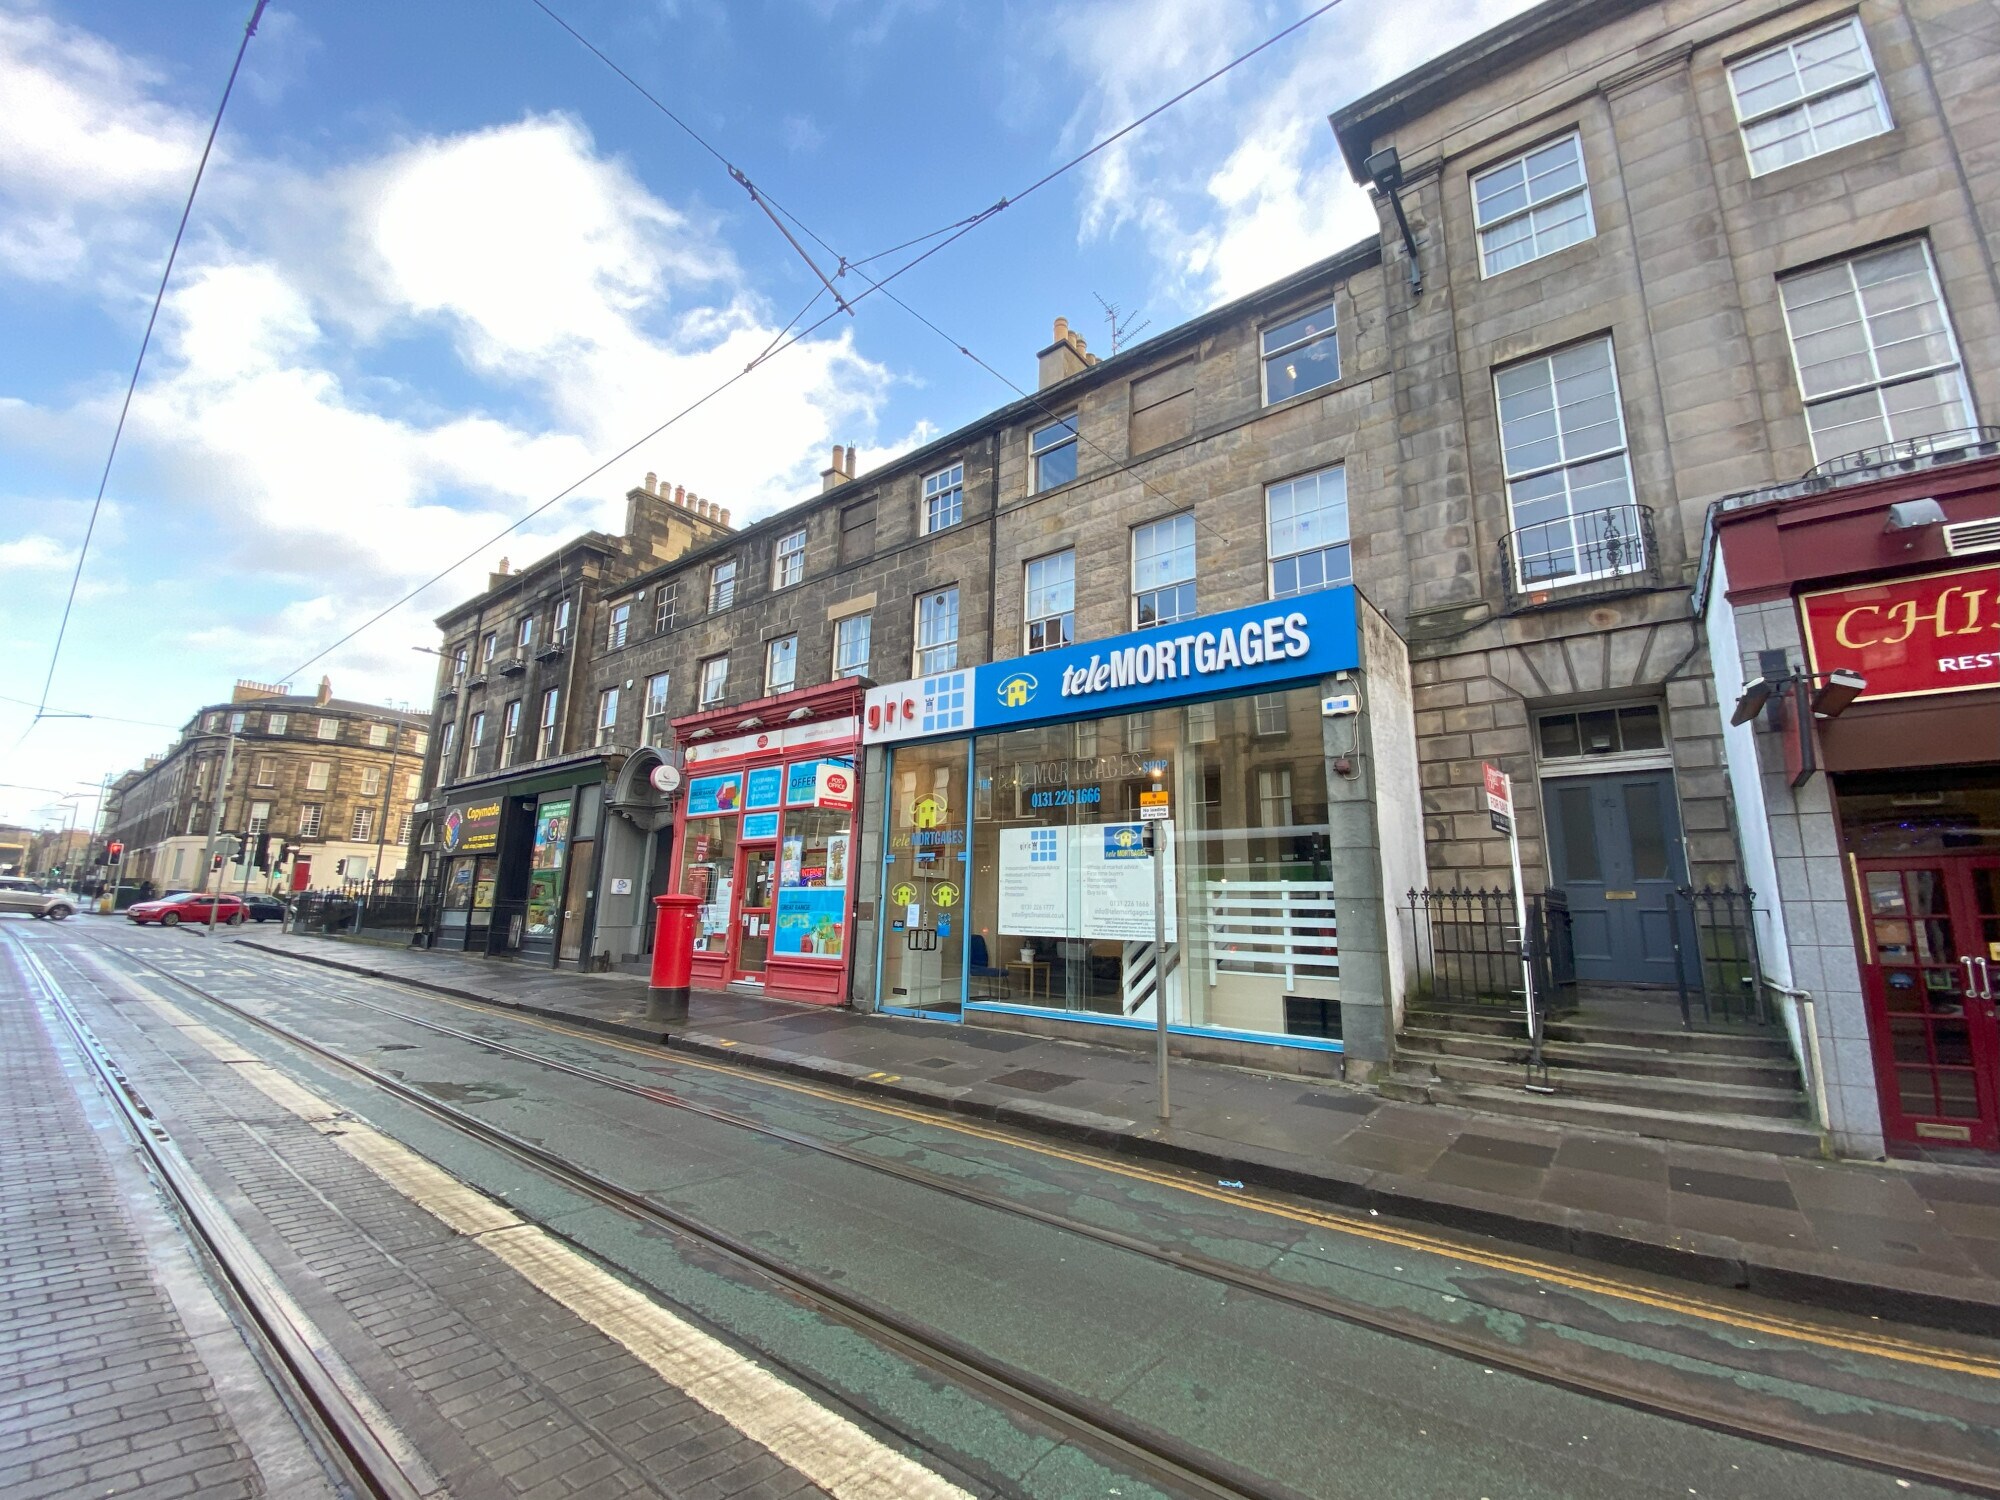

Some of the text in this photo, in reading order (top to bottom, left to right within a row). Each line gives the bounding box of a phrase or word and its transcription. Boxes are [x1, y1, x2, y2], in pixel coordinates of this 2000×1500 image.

[1835, 586, 2000, 649] CHI
[979, 779, 991, 789] THE
[1143, 760, 1167, 774] SHOP
[828, 782, 845, 790] OFFICE
[1031, 787, 1101, 808] 0131 226 1666
[892, 830, 964, 847] tele MORTGAGES
[779, 913, 809, 929] GIFTS
